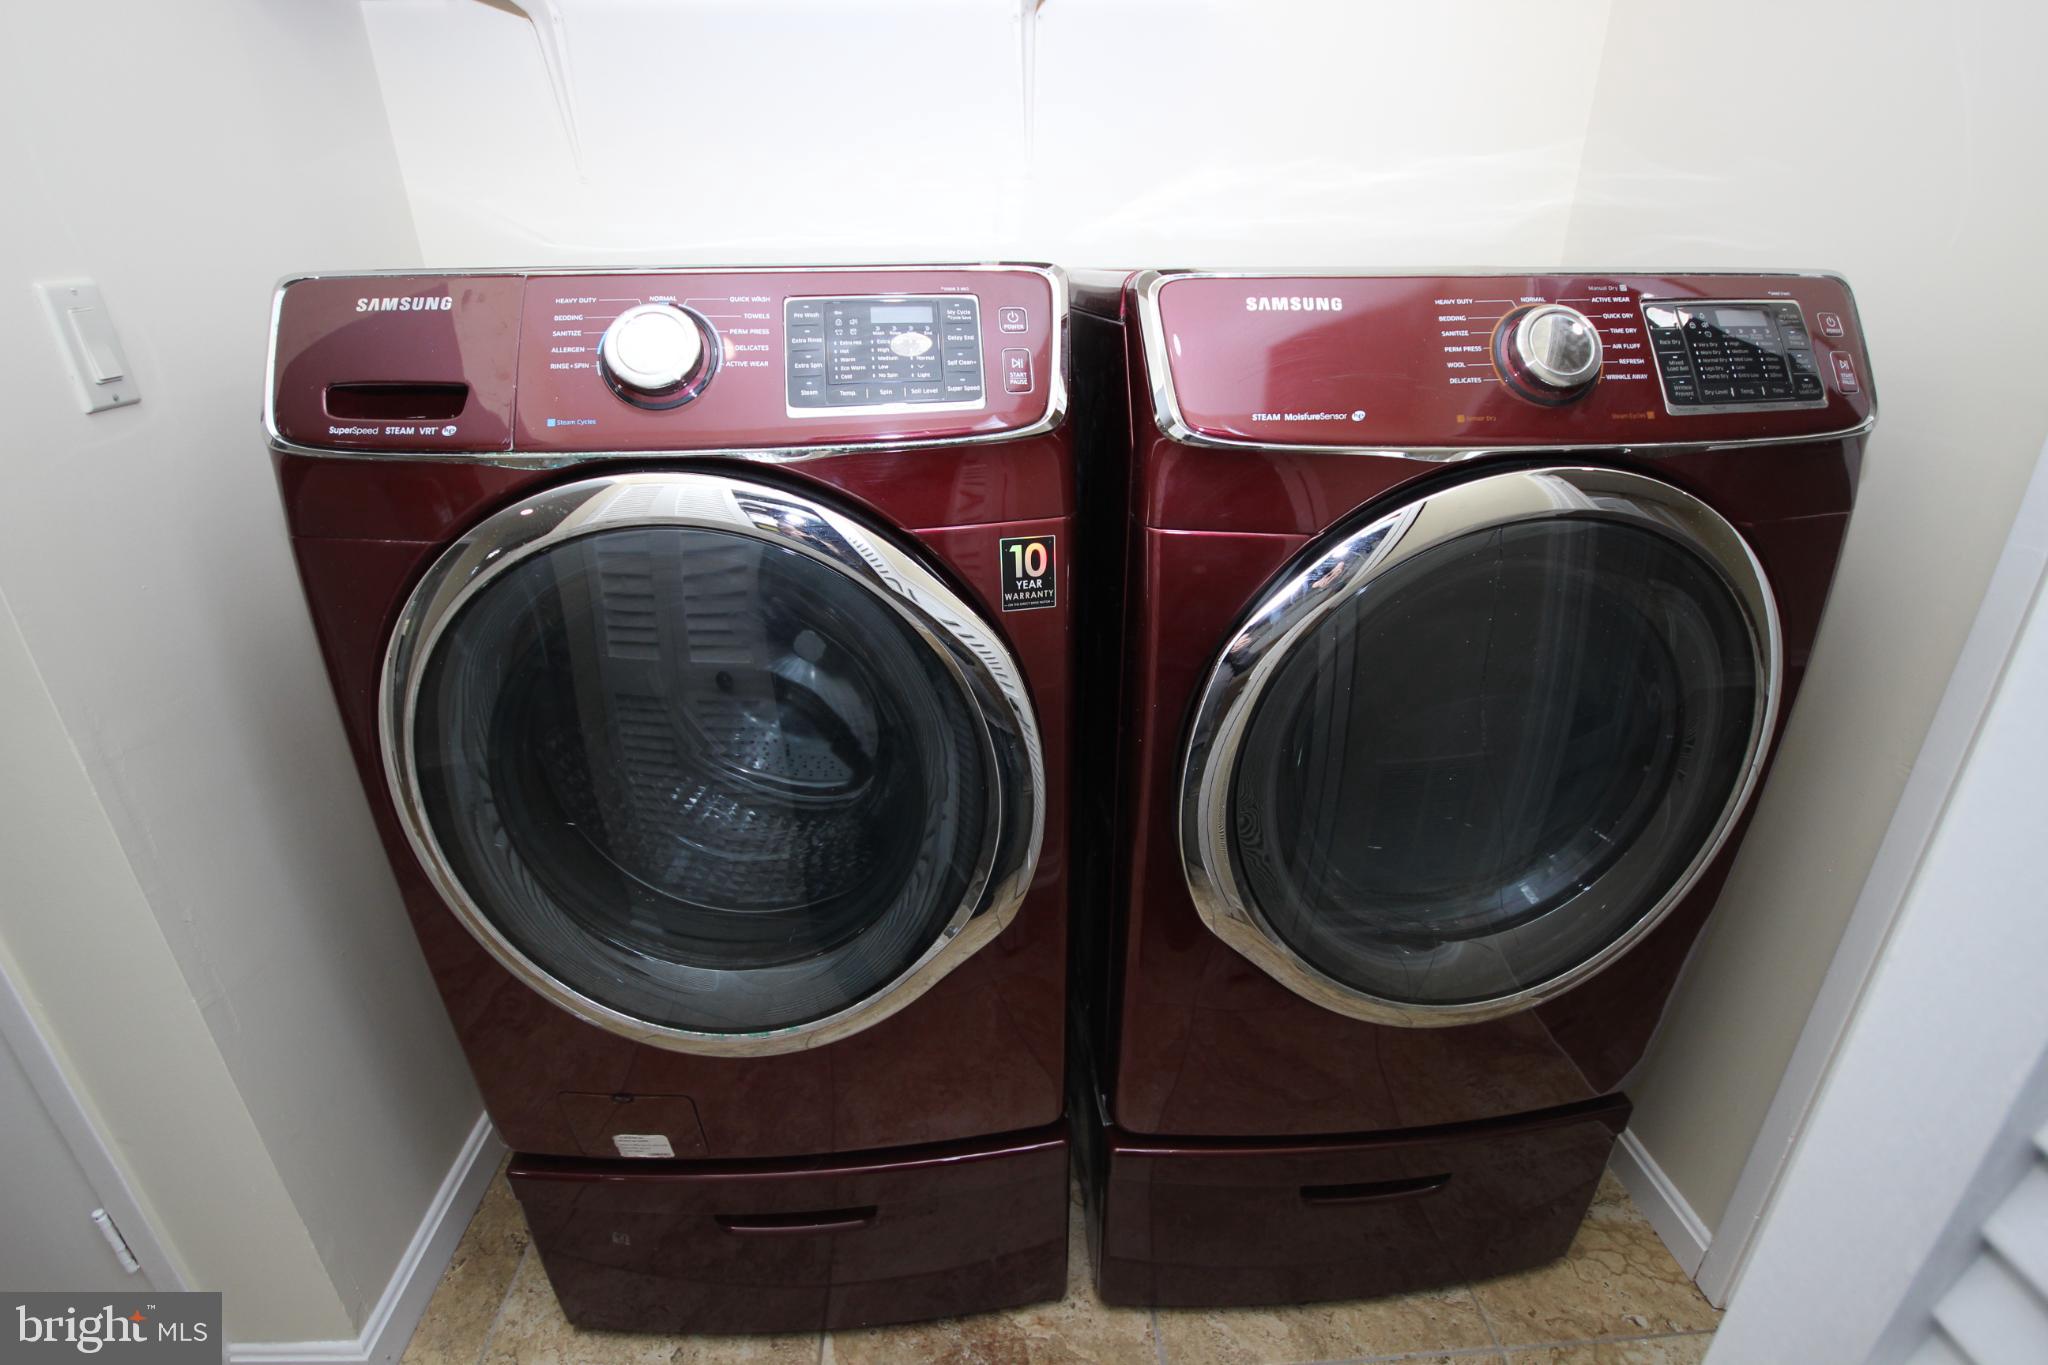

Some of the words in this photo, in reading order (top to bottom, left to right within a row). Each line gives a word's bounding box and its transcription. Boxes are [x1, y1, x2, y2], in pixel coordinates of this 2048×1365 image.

[356, 297, 452, 312] SAMSUNG
[1246, 297, 1342, 311] SAMSUNG
[385, 427, 414, 435] STEAM
[1009, 542, 1047, 578] 10
[1016, 579, 1042, 590] YEAR
[1005, 590, 1054, 600] WARRANTY
